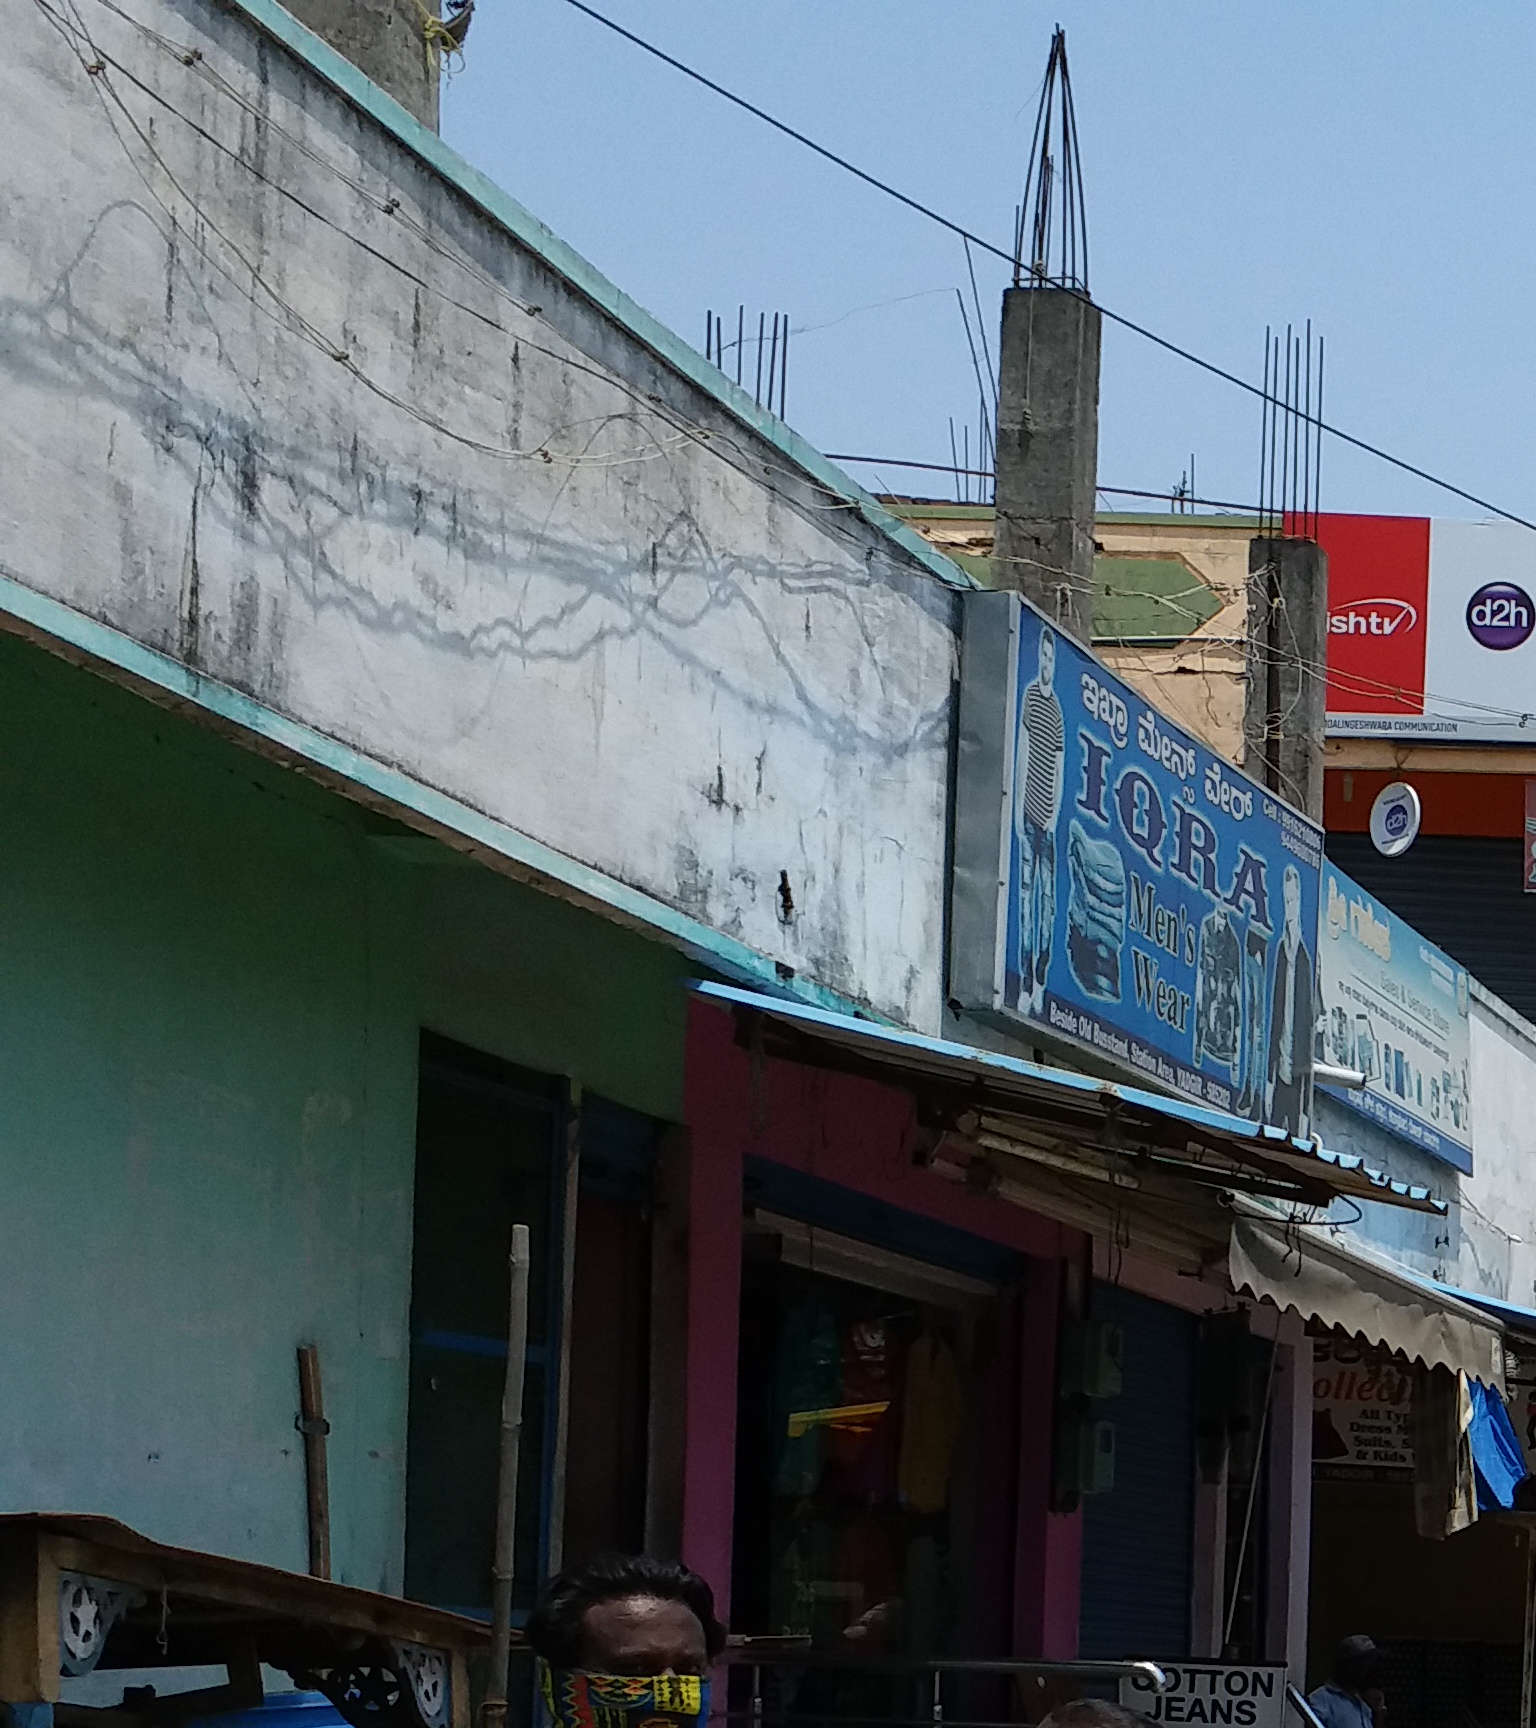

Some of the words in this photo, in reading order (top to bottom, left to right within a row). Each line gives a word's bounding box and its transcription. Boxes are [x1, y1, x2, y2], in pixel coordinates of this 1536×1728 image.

[1326, 603, 1413, 636] ishtv
[1471, 598, 1528, 629] d2h
[1327, 720, 1393, 731] DALINGESHWARA
[1394, 722, 1458, 732] COMMUNICATION
[1204, 762, 1253, 821] ವೇರ್
[1077, 732, 1273, 932] IQRA
[1129, 872, 1195, 966] Men's
[1131, 947, 1190, 1033] Wear
[1408, 990, 1432, 1021] Service
[1050, 1001, 1077, 1033] Beside
[1079, 1015, 1092, 1041] Old
[1130, 1043, 1157, 1074] Station
[1177, 1067, 1202, 1096] YADGIR
[1350, 1423, 1392, 1433] Dress
[1360, 1410, 1380, 1420] All
[1356, 1451, 1369, 1460] &
[1373, 1450, 1406, 1462] Kids
[1146, 1699, 1257, 1725] JEANS
